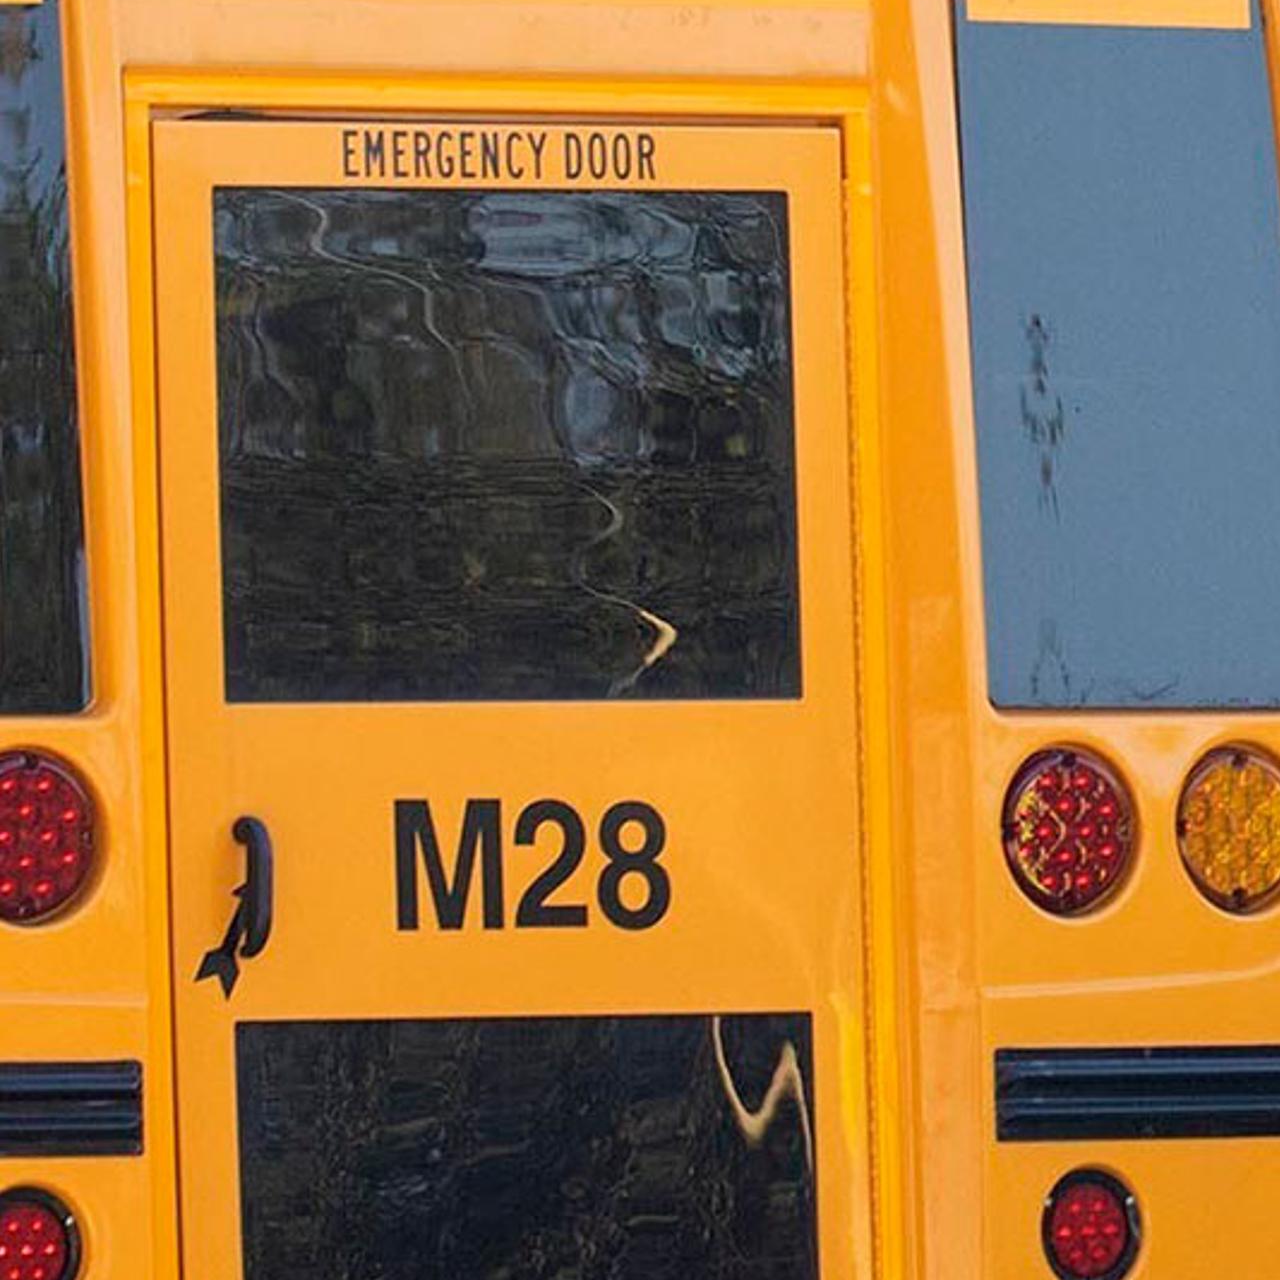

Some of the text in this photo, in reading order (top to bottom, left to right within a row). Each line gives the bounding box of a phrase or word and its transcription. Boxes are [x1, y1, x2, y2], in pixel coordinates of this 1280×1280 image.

[342, 129, 657, 181] EMERGENCY DOOR
[395, 800, 672, 931] M28
